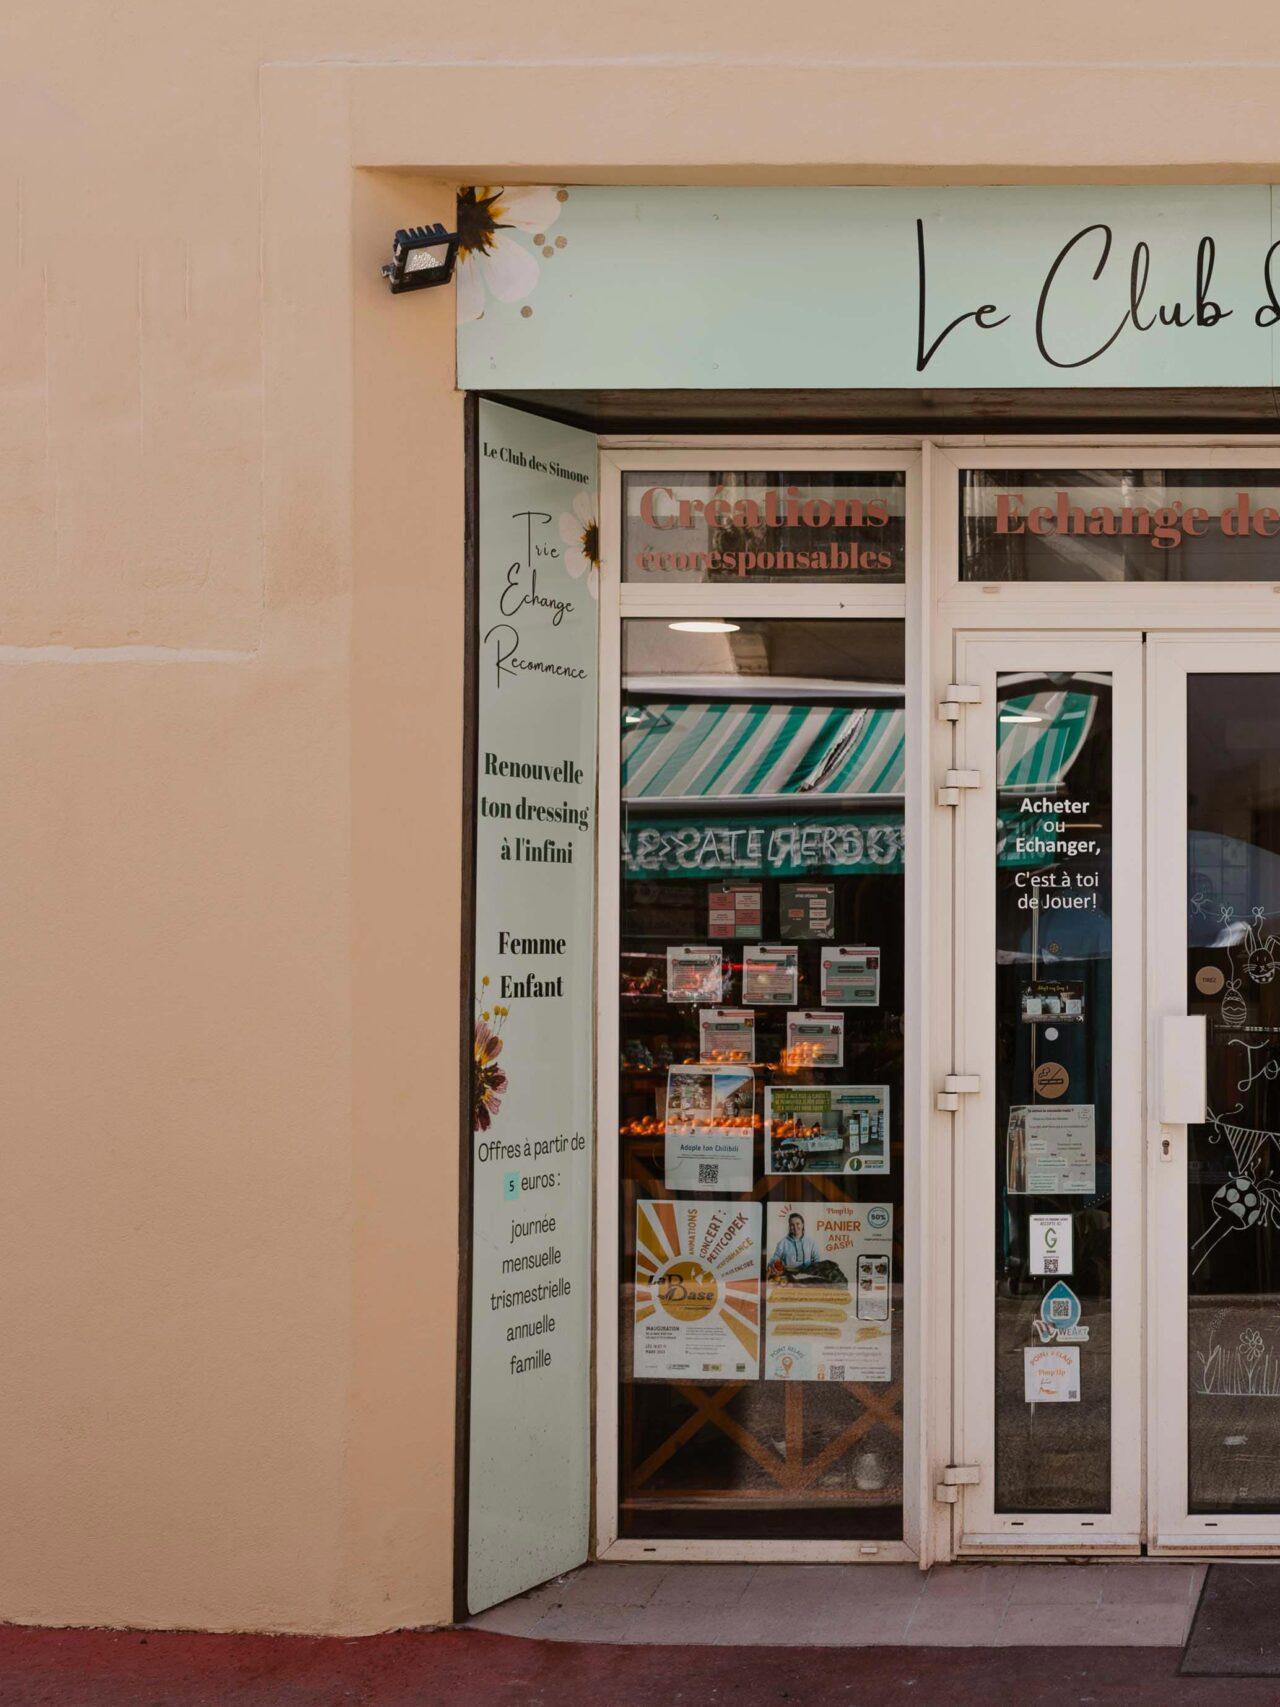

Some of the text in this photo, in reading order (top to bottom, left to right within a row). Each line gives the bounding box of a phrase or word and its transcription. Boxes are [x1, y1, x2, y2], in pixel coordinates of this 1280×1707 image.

[915, 218, 1010, 372] Le
[1036, 224, 1233, 368] Club
[483, 442, 589, 485] Le Club des Simone
[640, 484, 890, 529] Créations
[994, 492, 1209, 549] Echange
[1220, 493, 1280, 538] de
[512, 511, 560, 567] Trie
[635, 542, 893, 577] écoresponsables
[500, 562, 575, 626] Echange
[484, 624, 588, 689] Recommence
[484, 752, 584, 784] Renouvelle
[481, 796, 589, 831] ton dressing
[1020, 797, 1090, 813] Acheter
[1043, 821, 1066, 833] ou
[500, 836, 573, 864] à l'infini
[1016, 837, 1101, 856] Echanger,
[1015, 871, 1099, 887] C'est à toi
[1017, 893, 1039, 909] de
[498, 931, 567, 955] Femme
[500, 973, 564, 999] Enfant
[478, 1132, 586, 1162] Offres à partir de
[521, 1173, 556, 1191] euros
[510, 1213, 556, 1243] journée
[700, 1214, 723, 1258] CONCERT
[816, 1220, 861, 1232] PANIER
[828, 1234, 849, 1242] ANTI
[502, 1246, 562, 1274] mensuelle
[825, 1240, 854, 1252] GASPI
[490, 1277, 571, 1311] trismestrielle
[506, 1314, 556, 1342] annuelle
[510, 1349, 552, 1375] famille
